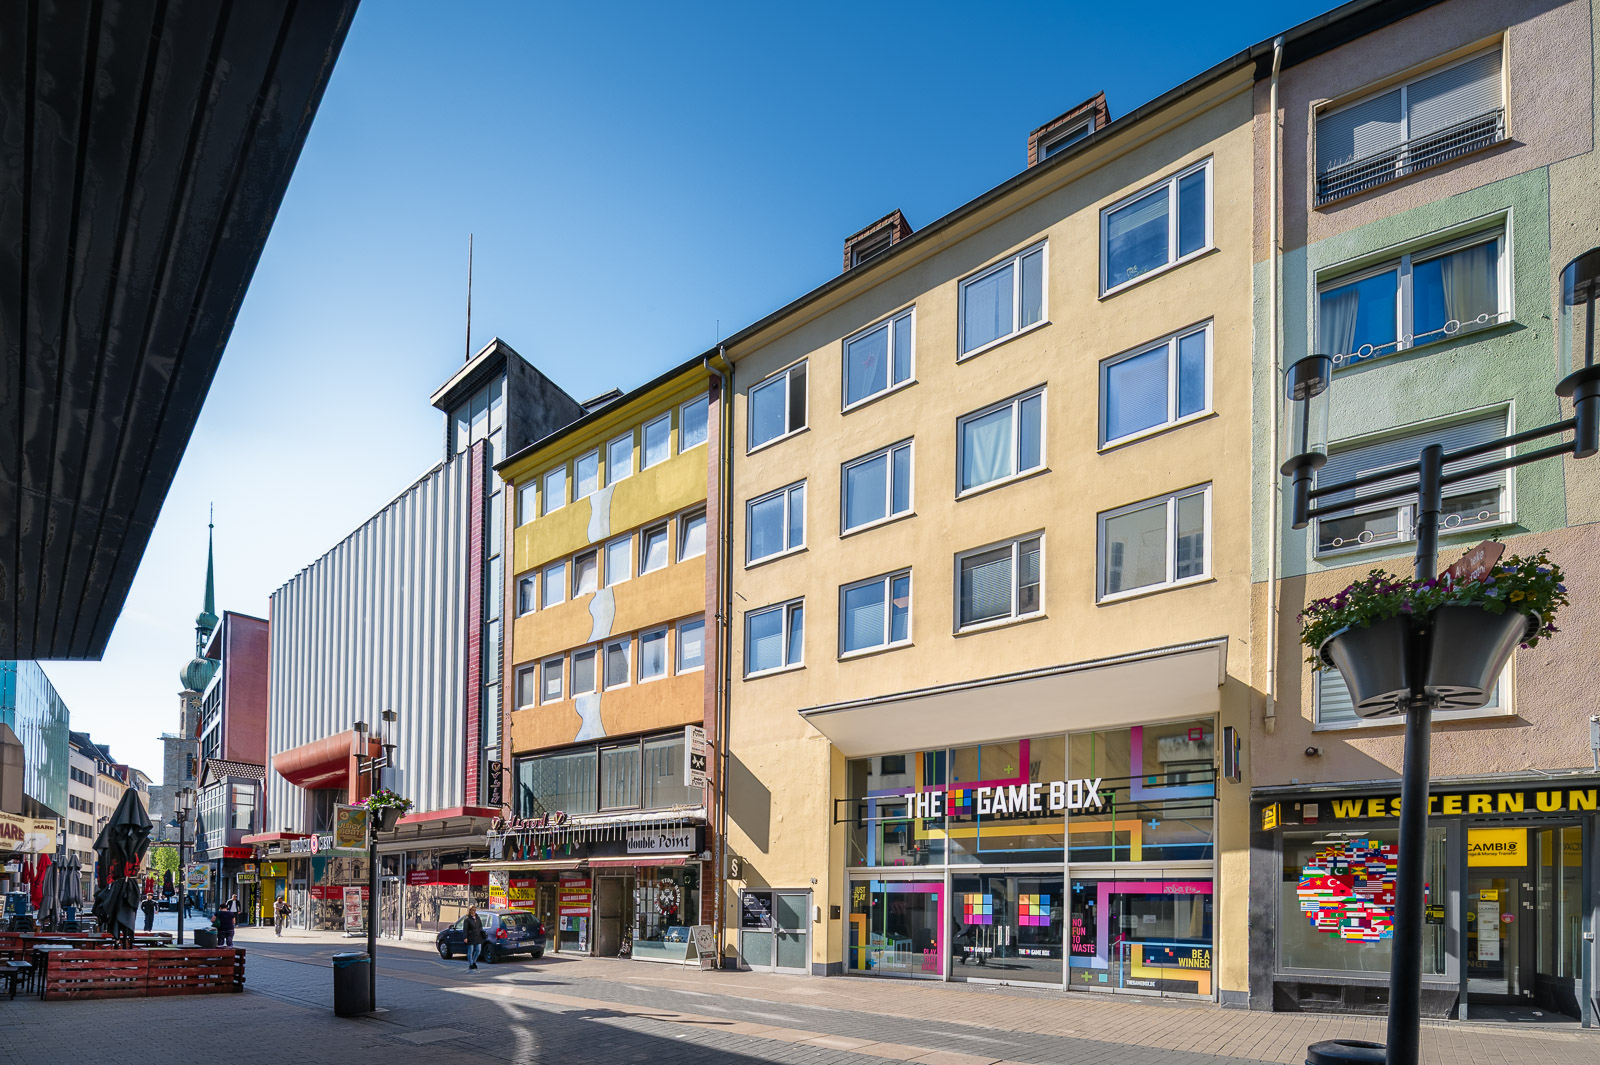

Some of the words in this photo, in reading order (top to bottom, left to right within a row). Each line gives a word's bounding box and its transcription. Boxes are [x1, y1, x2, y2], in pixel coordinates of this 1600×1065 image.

[904, 791, 942, 818] THE
[977, 782, 1042, 814] GAME
[1050, 778, 1102, 810] BOX
[628, 836, 655, 849] double
[658, 832, 689, 848] Point
[1072, 918, 1082, 927] NO
[1072, 927, 1086, 935] FUN
[1072, 944, 1095, 953] WASTE
[1192, 949, 1202, 958] BE
[1205, 950, 1210, 959] A
[1178, 958, 1210, 968] WINNER
